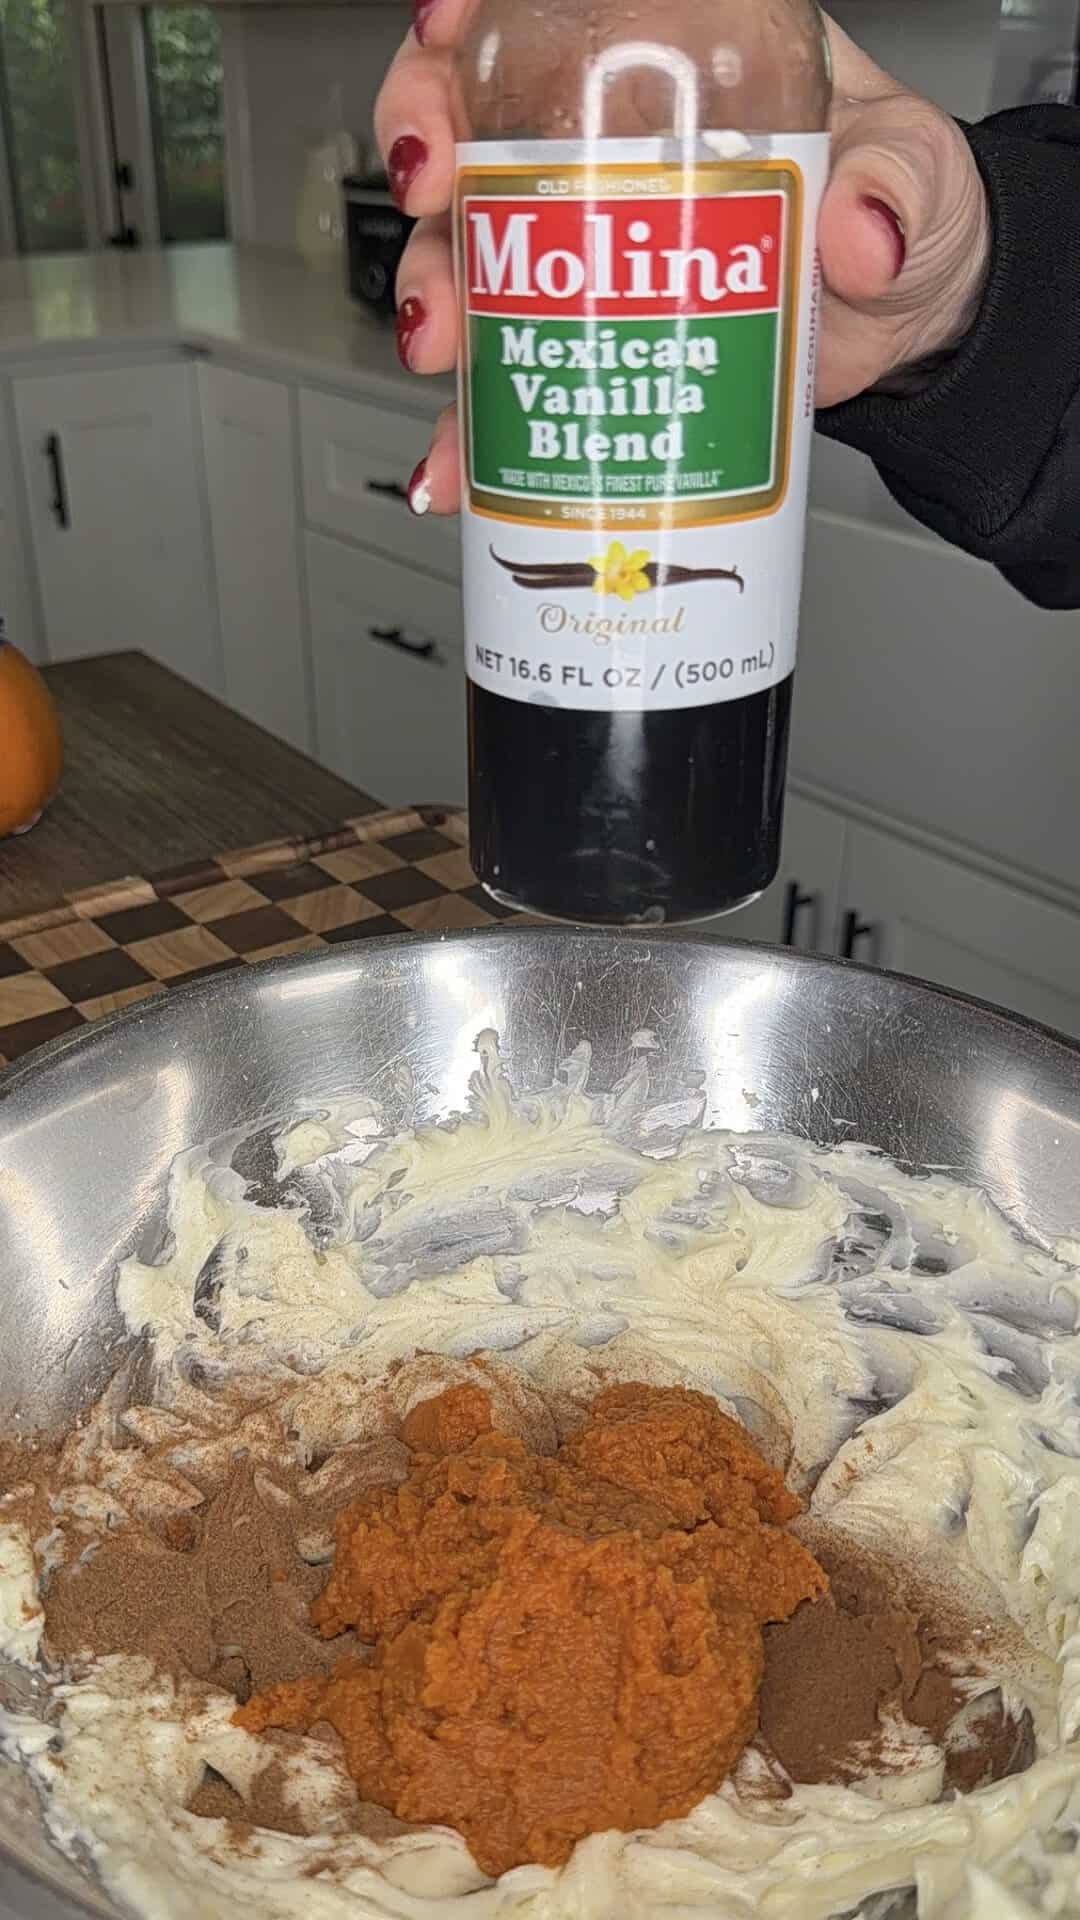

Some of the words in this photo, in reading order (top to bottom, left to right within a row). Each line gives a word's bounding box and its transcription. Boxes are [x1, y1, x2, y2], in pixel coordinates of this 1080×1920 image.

[537, 179, 568, 194] OLD
[574, 178, 671, 193] FSHIONED
[500, 325, 719, 370] Mexican
[511, 373, 705, 416] Vanilla
[804, 384, 813, 418] NO
[528, 420, 684, 461] Blend
[527, 472, 550, 490] WITH
[606, 476, 643, 493] FINEST
[645, 474, 675, 492] PURE
[560, 507, 607, 520] SINCE
[610, 508, 647, 520] 1944
[537, 602, 685, 646] Original
[475, 644, 503, 671] NET
[510, 656, 552, 683] 16.6
[561, 666, 592, 687] FL
[603, 668, 640, 687] OZ
[650, 664, 665, 690] /
[674, 657, 733, 688] (500
[741, 641, 775, 671] mL)
